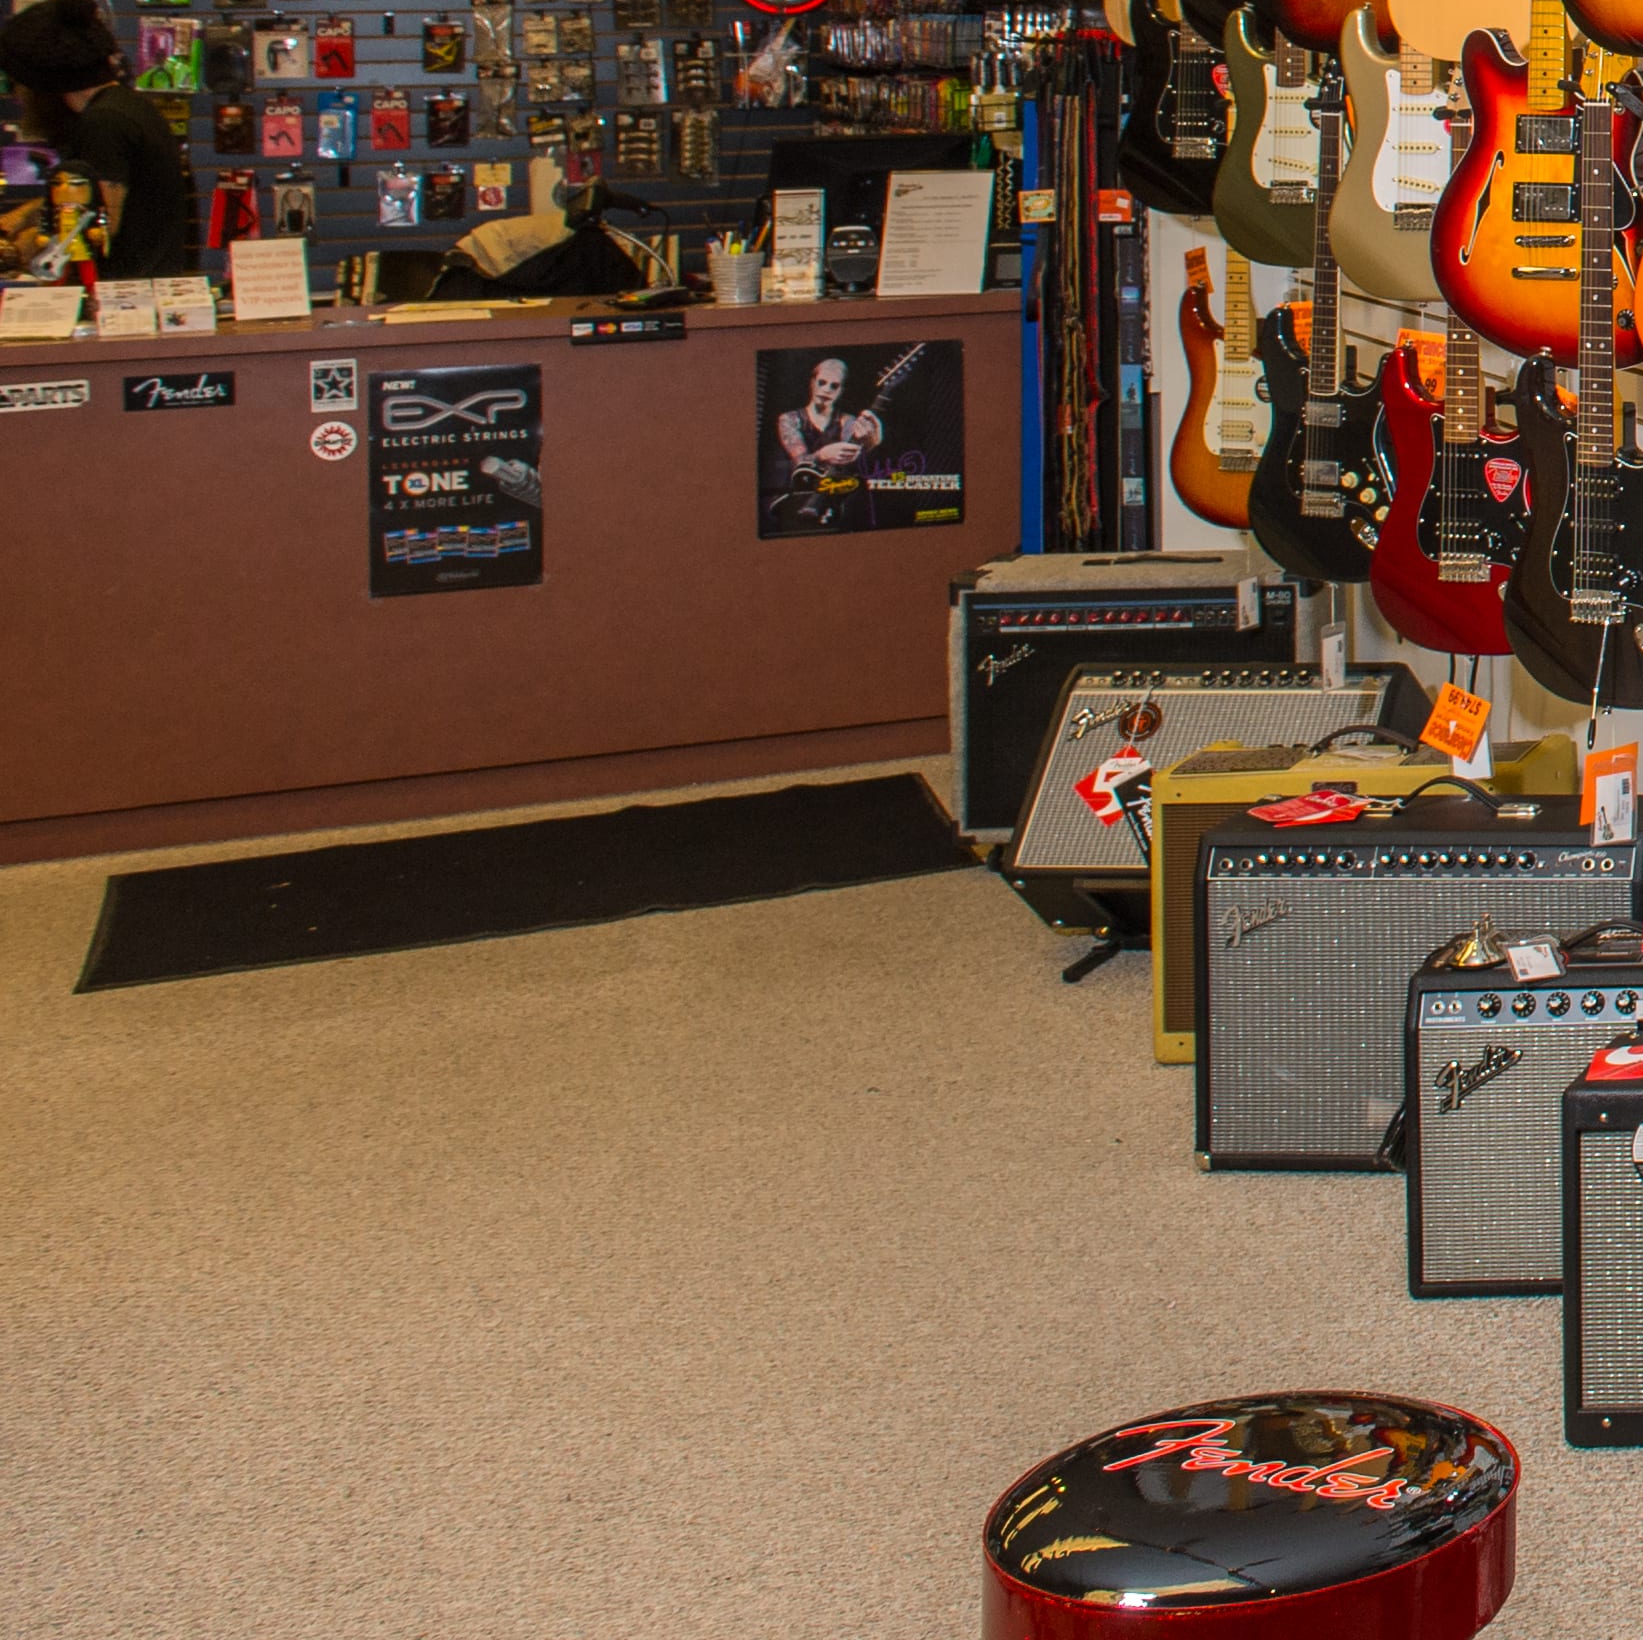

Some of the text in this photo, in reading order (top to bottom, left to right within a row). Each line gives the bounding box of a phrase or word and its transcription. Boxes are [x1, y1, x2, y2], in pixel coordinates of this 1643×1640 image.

[316, 27, 352, 37] CAPO
[265, 105, 302, 115] CAPO
[374, 100, 408, 109] CAPO
[132, 374, 229, 408] Fender
[381, 379, 417, 390] NEW!
[382, 388, 528, 431] EXP
[381, 429, 529, 448] ELECTRIC STRINGS
[381, 470, 470, 496] TONE
[867, 479, 961, 491] TELECASTER
[384, 493, 495, 510] 4 X MORE LIFE
[977, 642, 1036, 688] Fender
[1067, 696, 1133, 742] Fender
[1219, 894, 1294, 949] Fender
[1433, 1044, 1525, 1115] Fender
[1104, 1419, 1408, 1511] Fender
